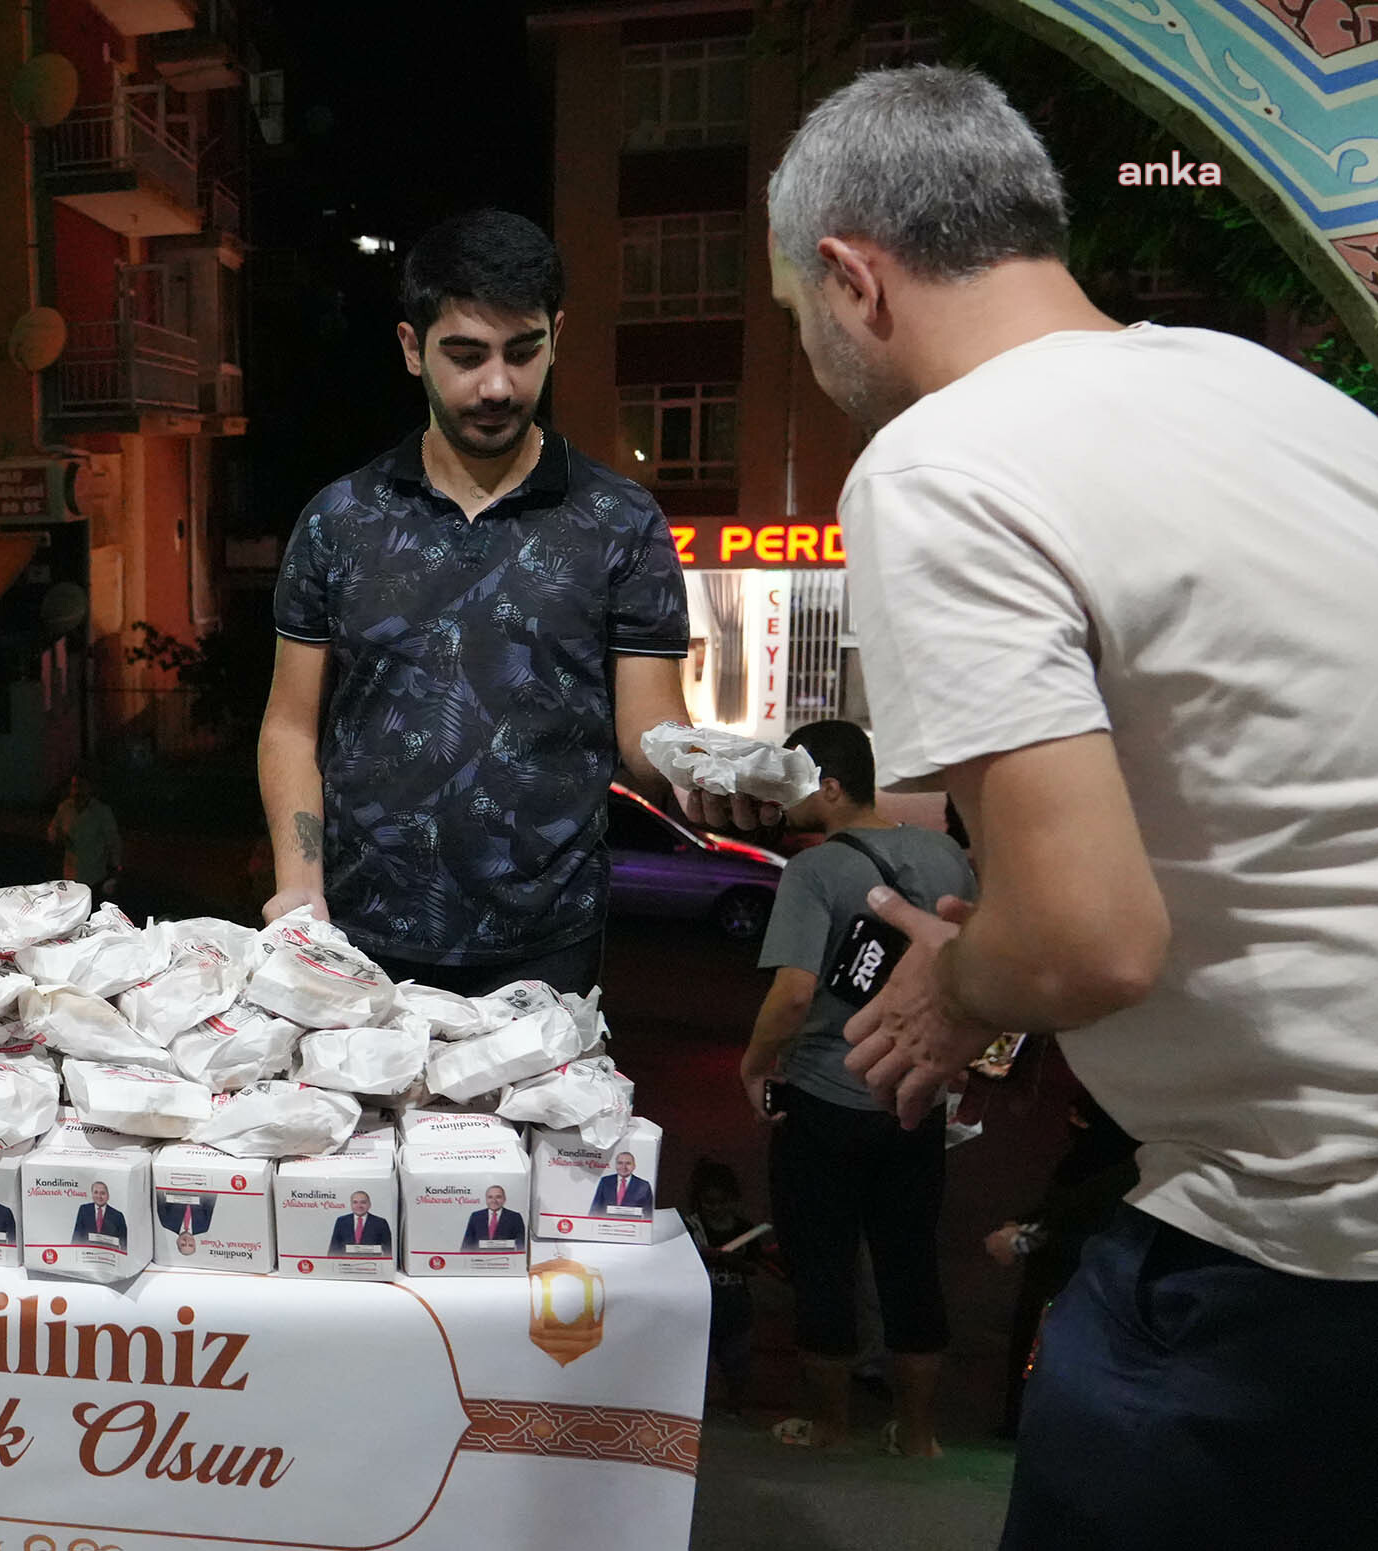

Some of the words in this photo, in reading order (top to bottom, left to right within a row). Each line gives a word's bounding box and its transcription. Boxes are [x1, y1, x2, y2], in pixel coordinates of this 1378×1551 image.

[430, 1121, 490, 1132] Kandilimiz
[557, 1148, 602, 1160] Kandilimiz
[35, 1178, 79, 1188] Kandilimiz
[291, 1190, 336, 1200] Kandilimiz
[425, 1186, 471, 1195] Kandilimiz
[209, 1248, 253, 1260] Kandilimiz
[72, 1399, 296, 1489] Olsun
